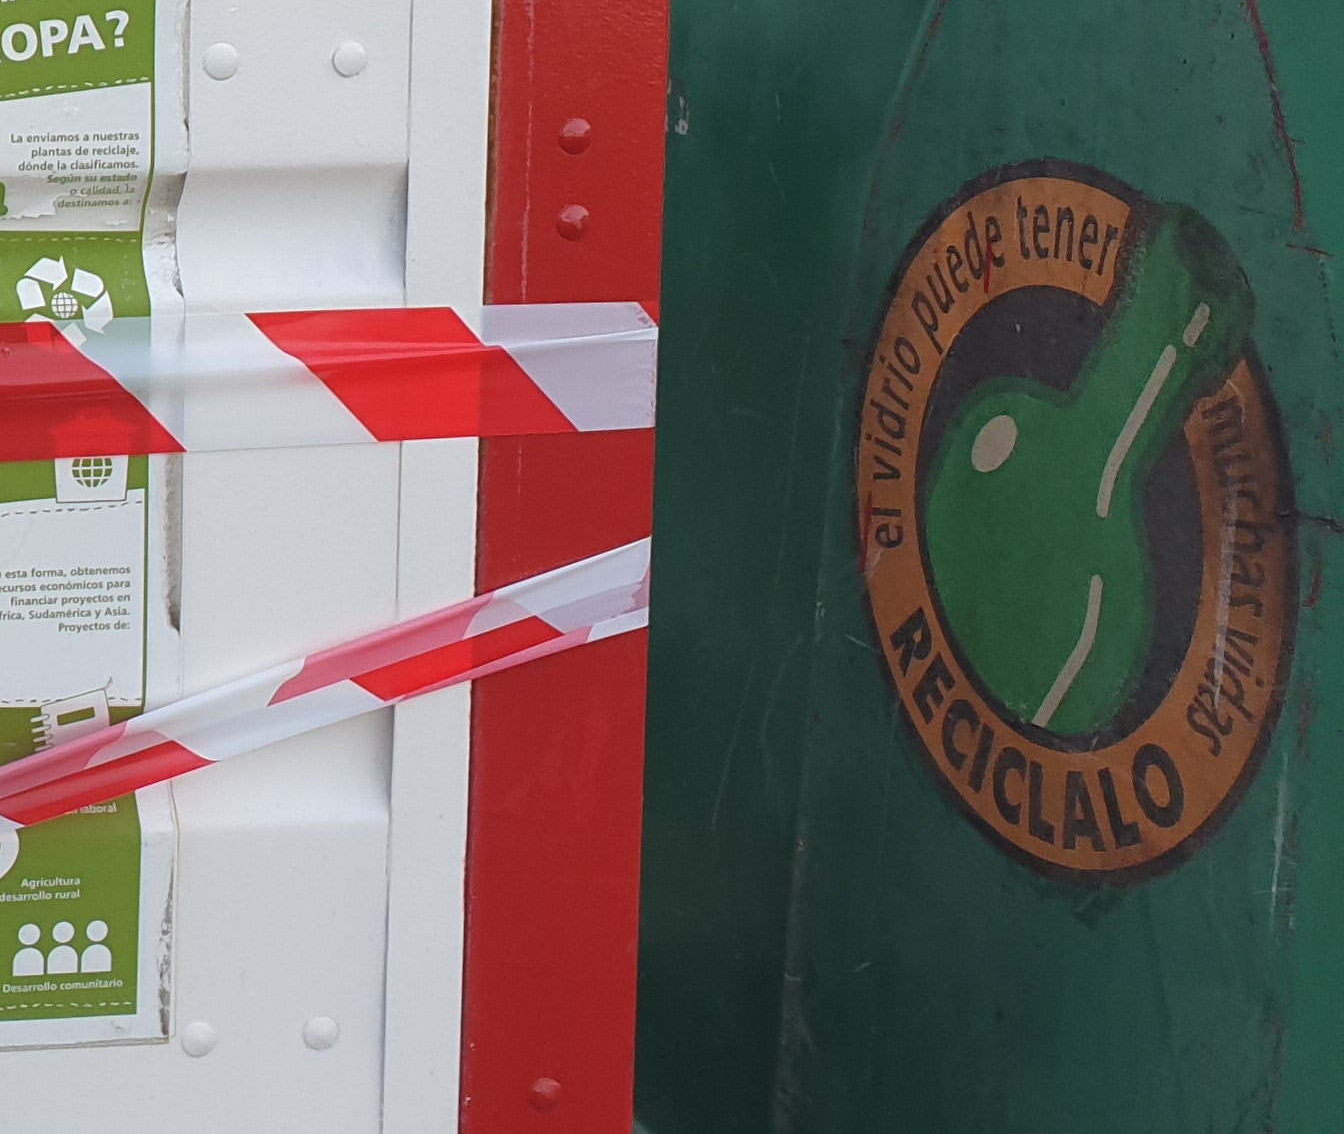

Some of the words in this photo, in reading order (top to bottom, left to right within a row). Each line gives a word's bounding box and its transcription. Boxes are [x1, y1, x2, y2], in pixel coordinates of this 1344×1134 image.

[10, 133, 23, 143] La
[26, 132, 80, 143] enviamos
[82, 134, 89, 142] a
[93, 132, 140, 141] nuestras
[31, 145, 72, 159] plantas
[75, 145, 89, 156] de
[92, 145, 140, 157] reciclaje,
[18, 160, 53, 171] dónde
[57, 160, 67, 170] la
[70, 160, 139, 170] clasificamos.
[46, 173, 81, 185] Según
[100, 173, 138, 182] estado
[80, 185, 122, 196] calidad,
[57, 198, 120, 208] destinamos
[1016, 196, 1120, 276] tener
[911, 210, 1005, 355] puede
[865, 336, 921, 482] vidrio
[872, 506, 904, 549] el
[5, 570, 27, 579] esta
[30, 568, 66, 578] forma,
[70, 566, 131, 576] obtenemos
[39, 580, 103, 591] económicos
[106, 580, 131, 591] para
[10, 596, 58, 606] financiar
[61, 594, 113, 607] proyectos
[117, 593, 131, 602] en
[28, 608, 91, 620] Sudamérica
[94, 609, 101, 619] y
[58, 621, 110, 633] Proyectos
[113, 620, 130, 630] de:
[889, 607, 1185, 852] RECICLALO
[20, 876, 81, 890] Agricultura
[55, 889, 80, 899] rural
[2, 981, 57, 994] Desarrollo
[59, 977, 124, 991] comunitario
